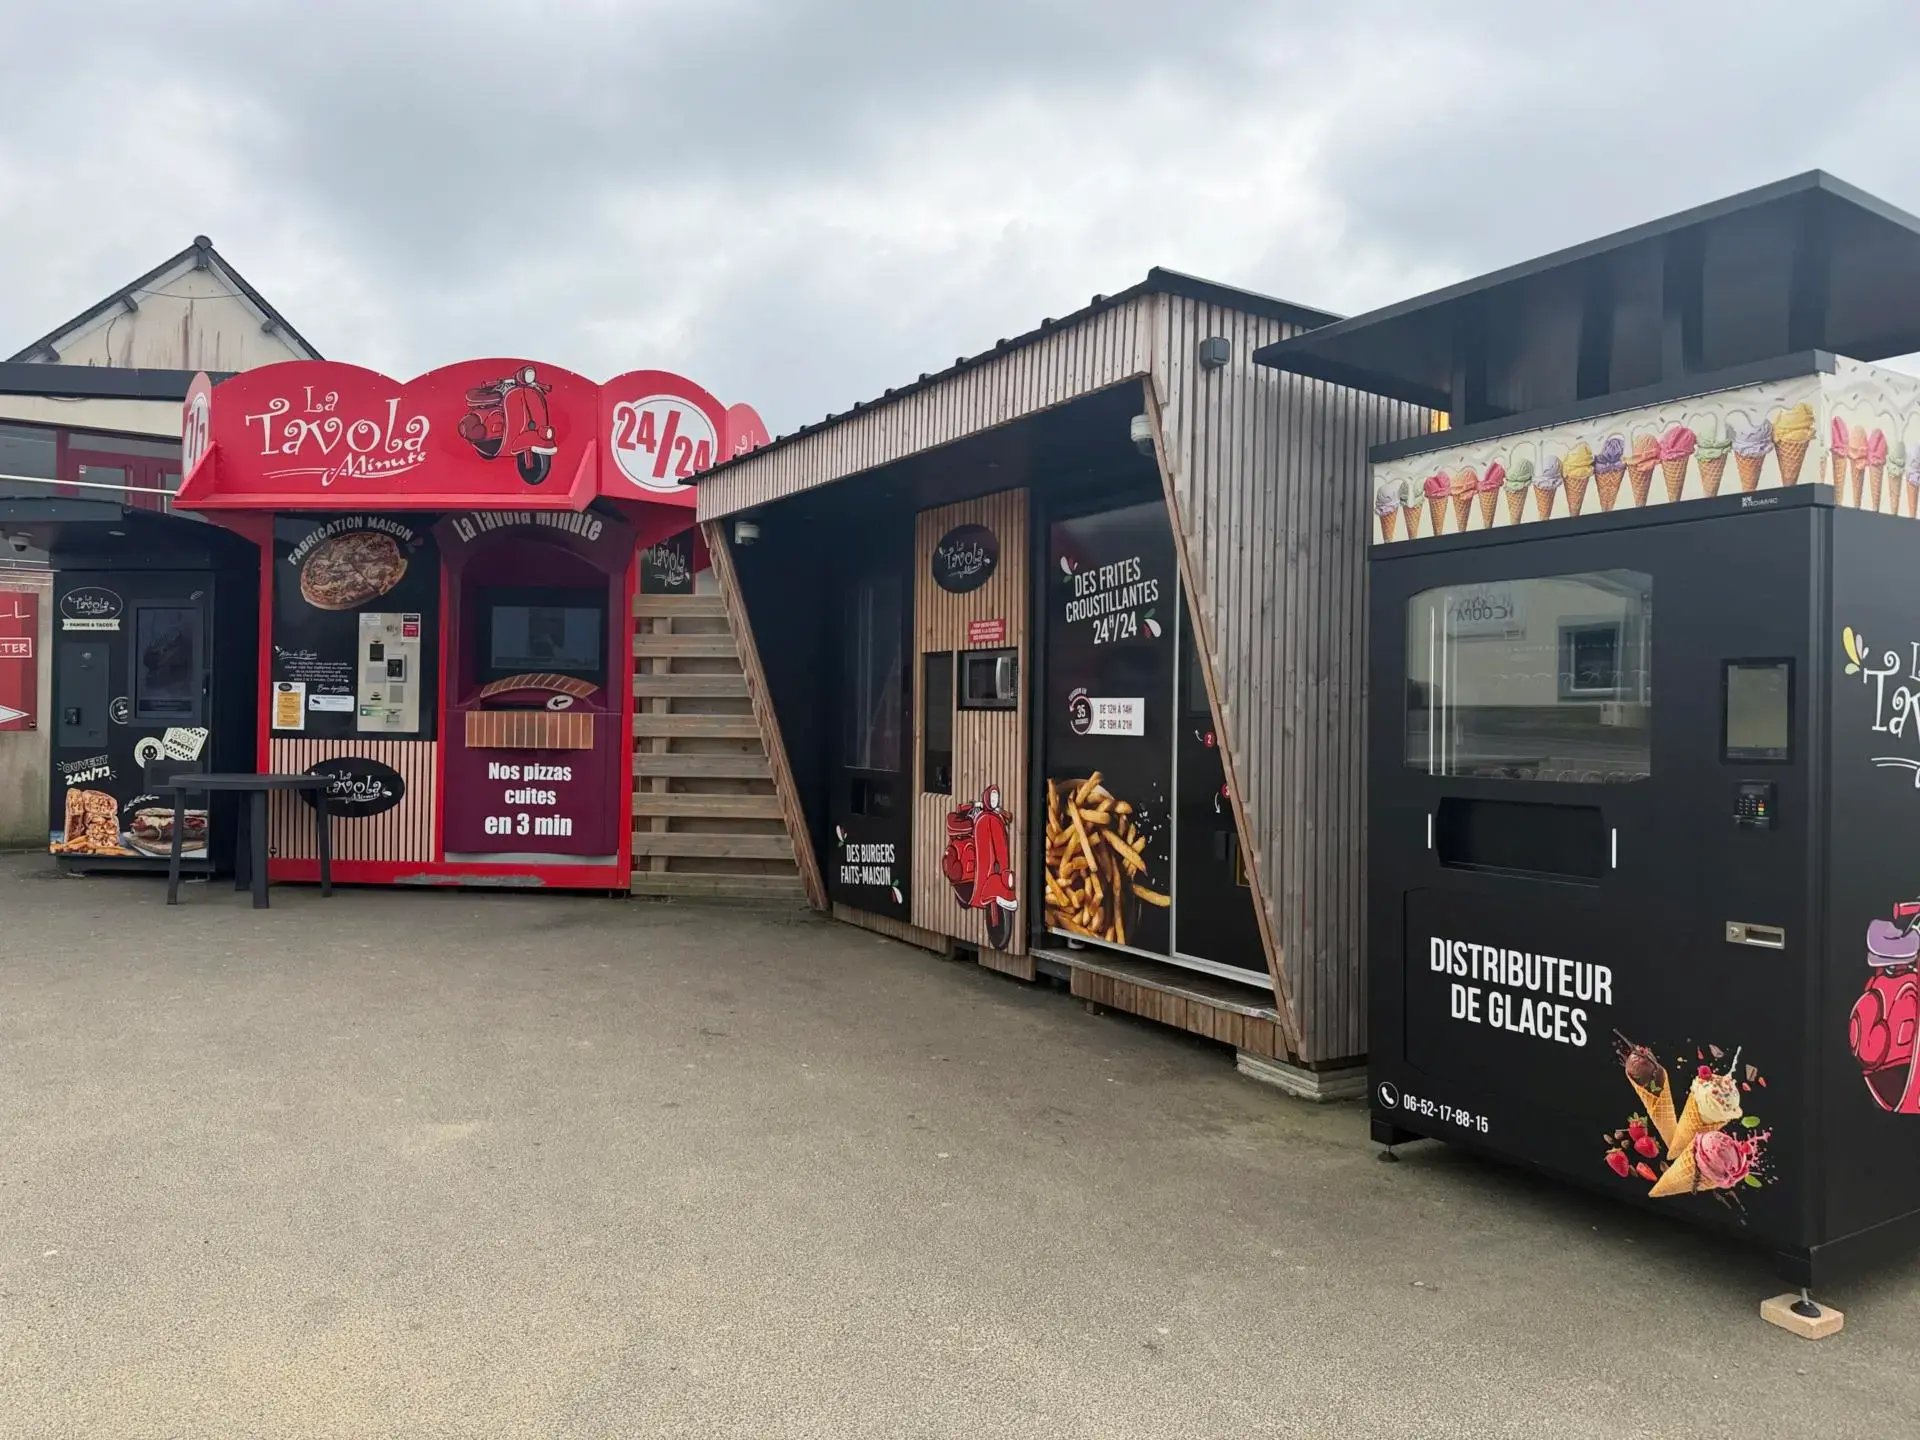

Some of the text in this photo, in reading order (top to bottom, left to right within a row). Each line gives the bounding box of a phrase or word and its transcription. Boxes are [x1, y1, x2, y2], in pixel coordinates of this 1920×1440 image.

[304, 385, 339, 413] La
[245, 397, 430, 456] Tavola
[617, 406, 710, 478] 24/24
[321, 452, 427, 487] Minute
[288, 516, 414, 566] FABRICATION MAISON
[452, 517, 477, 543] La
[944, 542, 984, 569] Tavola
[1074, 556, 1141, 597] DES FRITES
[72, 597, 109, 609] Tavola
[1065, 579, 1159, 623] CROUSTILLANTES
[1077, 704, 1086, 718] 35
[168, 738, 195, 753] APPETIT
[171, 729, 198, 748] BON
[63, 754, 108, 773] OUVERT
[65, 765, 110, 786] 24H/7J
[488, 762, 572, 781] Nos pizzas
[504, 787, 556, 805] cuites
[484, 813, 572, 836] en 3 min
[846, 844, 895, 863] DES BURGERS
[841, 865, 891, 886] FAITS-MAISON
[1430, 936, 1612, 1006] DISTRIBUTEUR
[1451, 983, 1588, 1047] DE GLACES
[1403, 1093, 1489, 1133] 06-52-17-88-15
